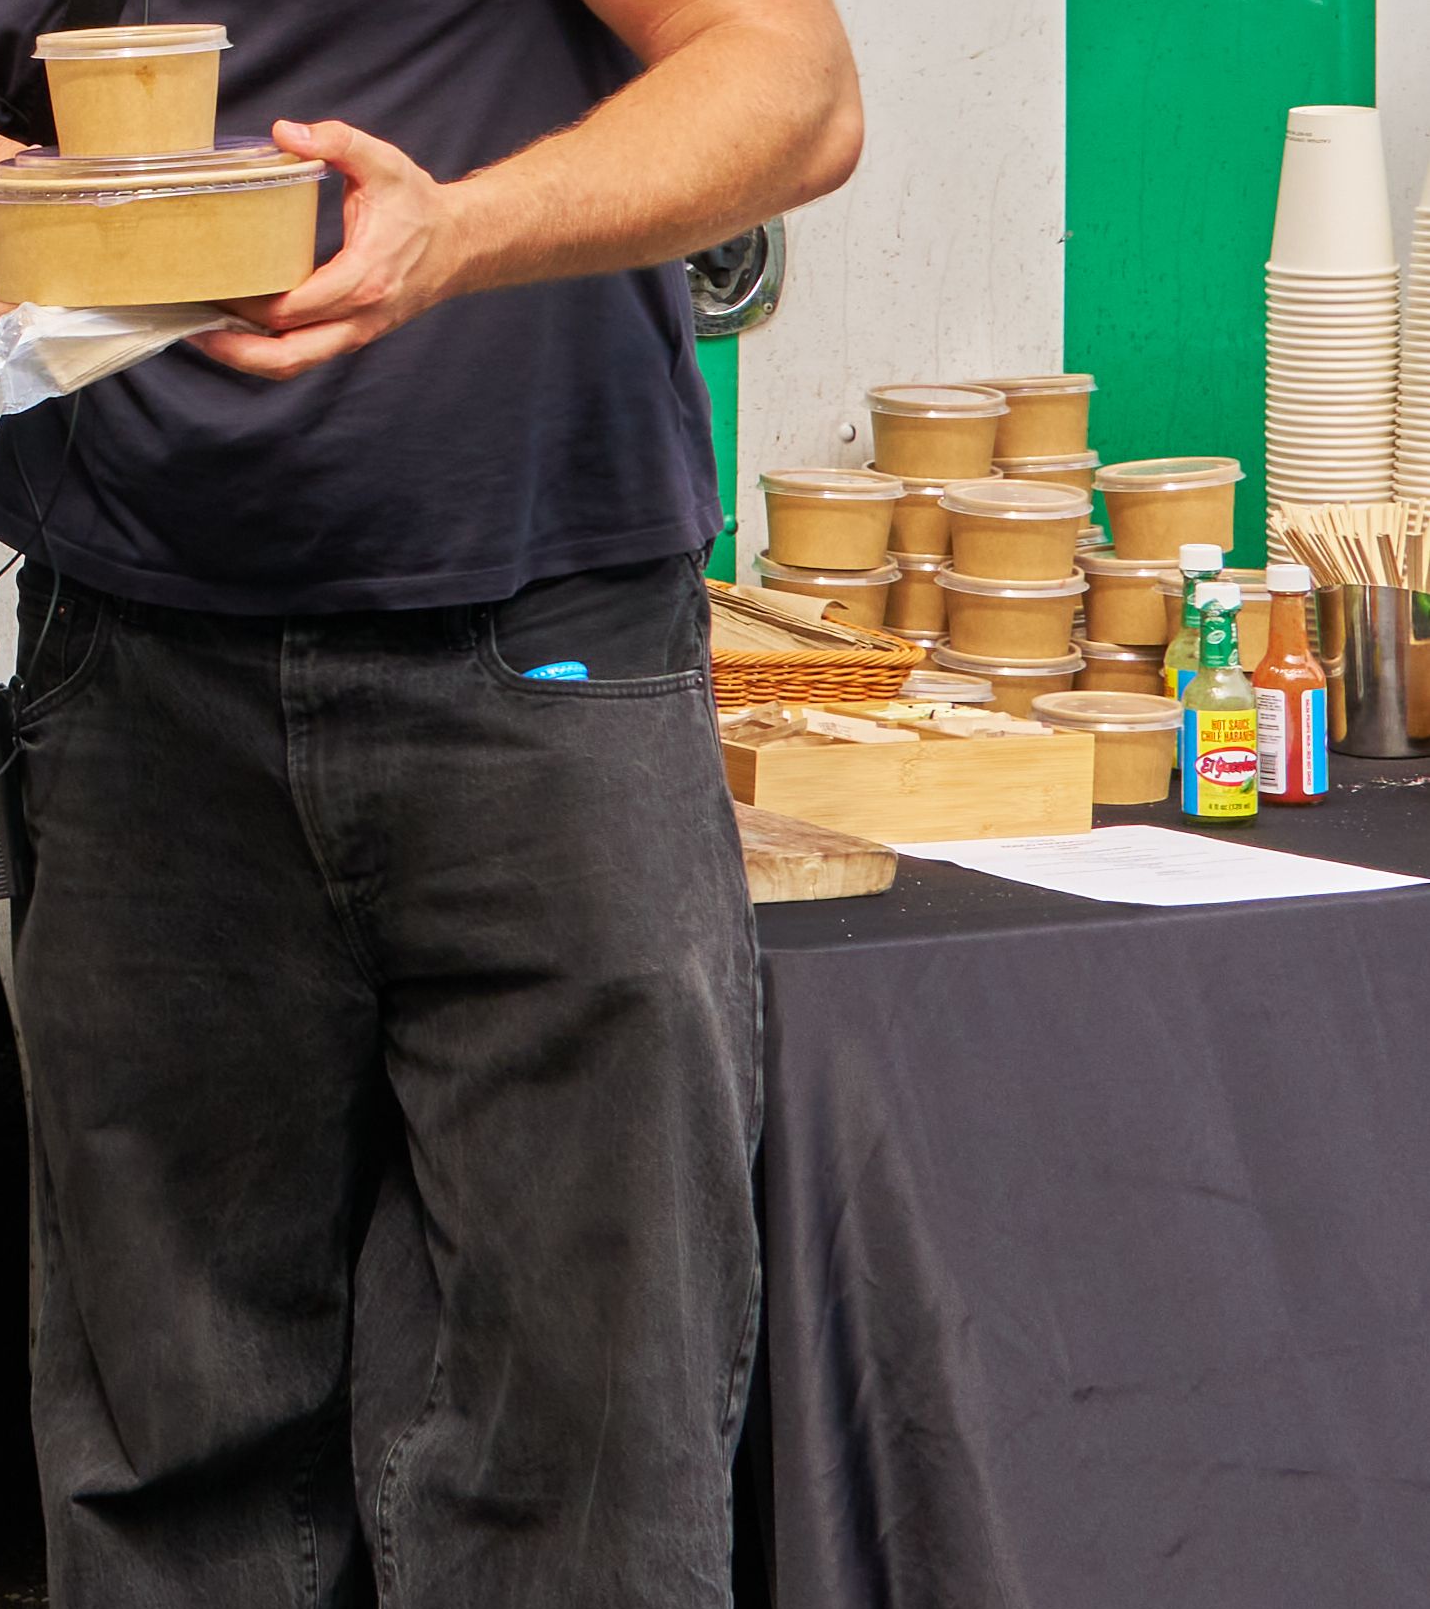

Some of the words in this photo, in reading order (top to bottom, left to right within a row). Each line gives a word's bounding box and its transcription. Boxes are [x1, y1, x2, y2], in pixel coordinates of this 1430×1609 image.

[1211, 719, 1226, 730] HOT
[1229, 719, 1250, 730] SAUCE
[1201, 731, 1221, 742] CHILE
